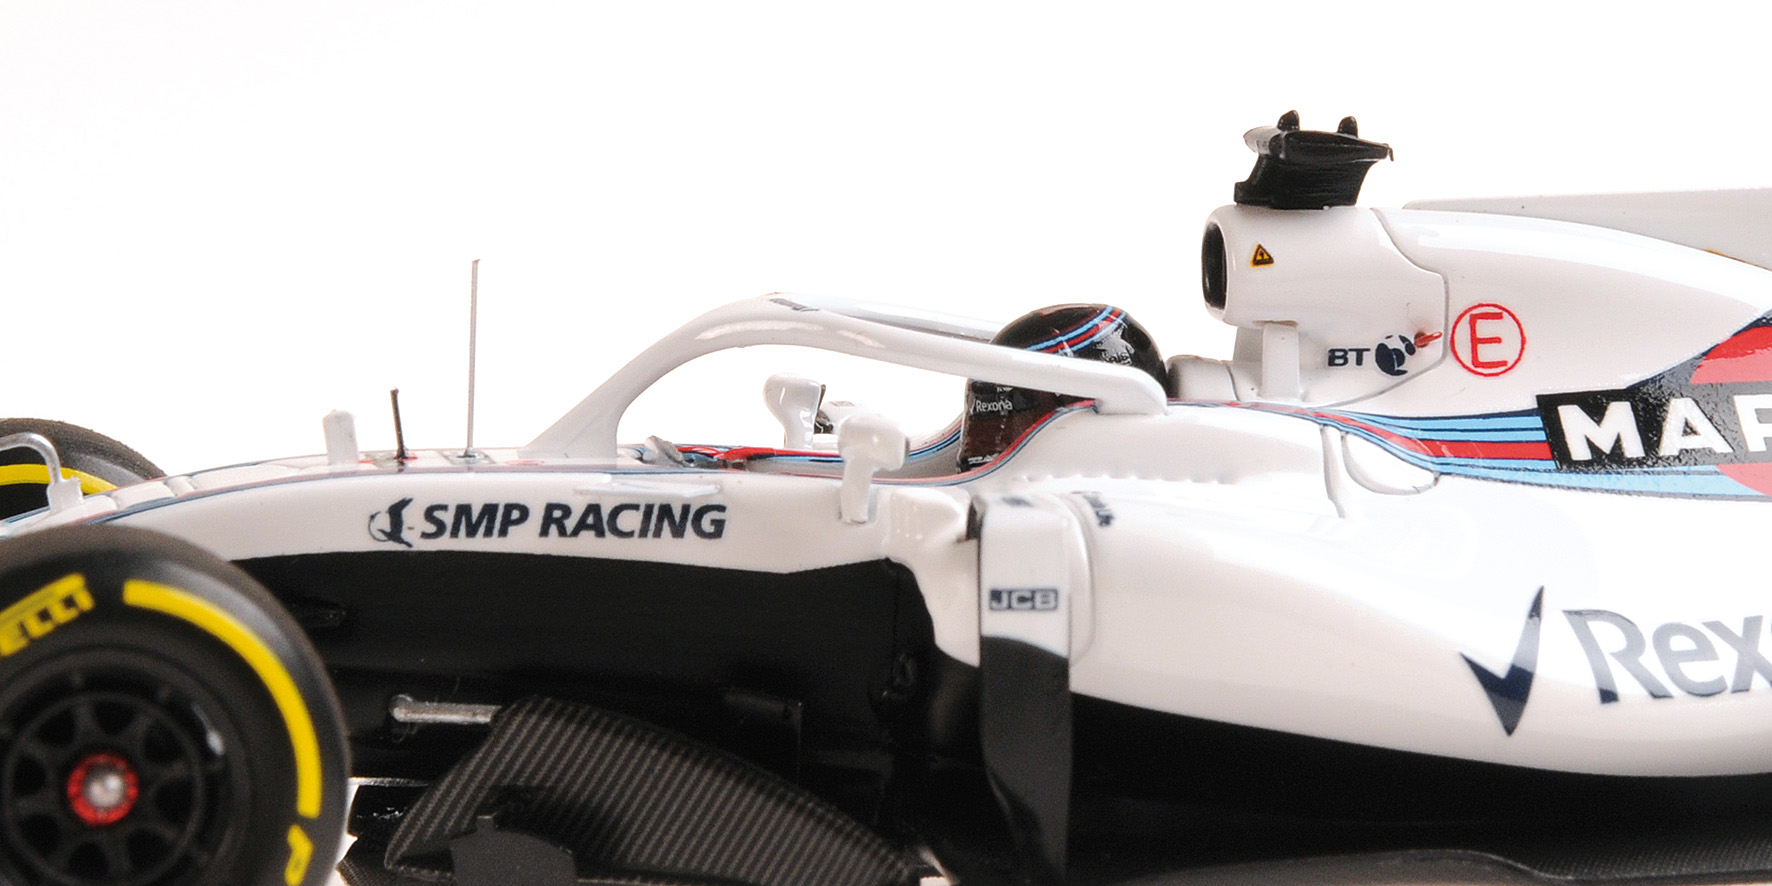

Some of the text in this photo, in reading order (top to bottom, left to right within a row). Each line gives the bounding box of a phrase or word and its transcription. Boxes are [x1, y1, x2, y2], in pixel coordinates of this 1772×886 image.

[1469, 311, 1508, 369] E
[1328, 348, 1371, 367] BT
[975, 399, 1013, 412] Rexona
[420, 503, 727, 540] SMP RACING
[990, 590, 1057, 611] JCB
[1561, 609, 1772, 704] Rex
